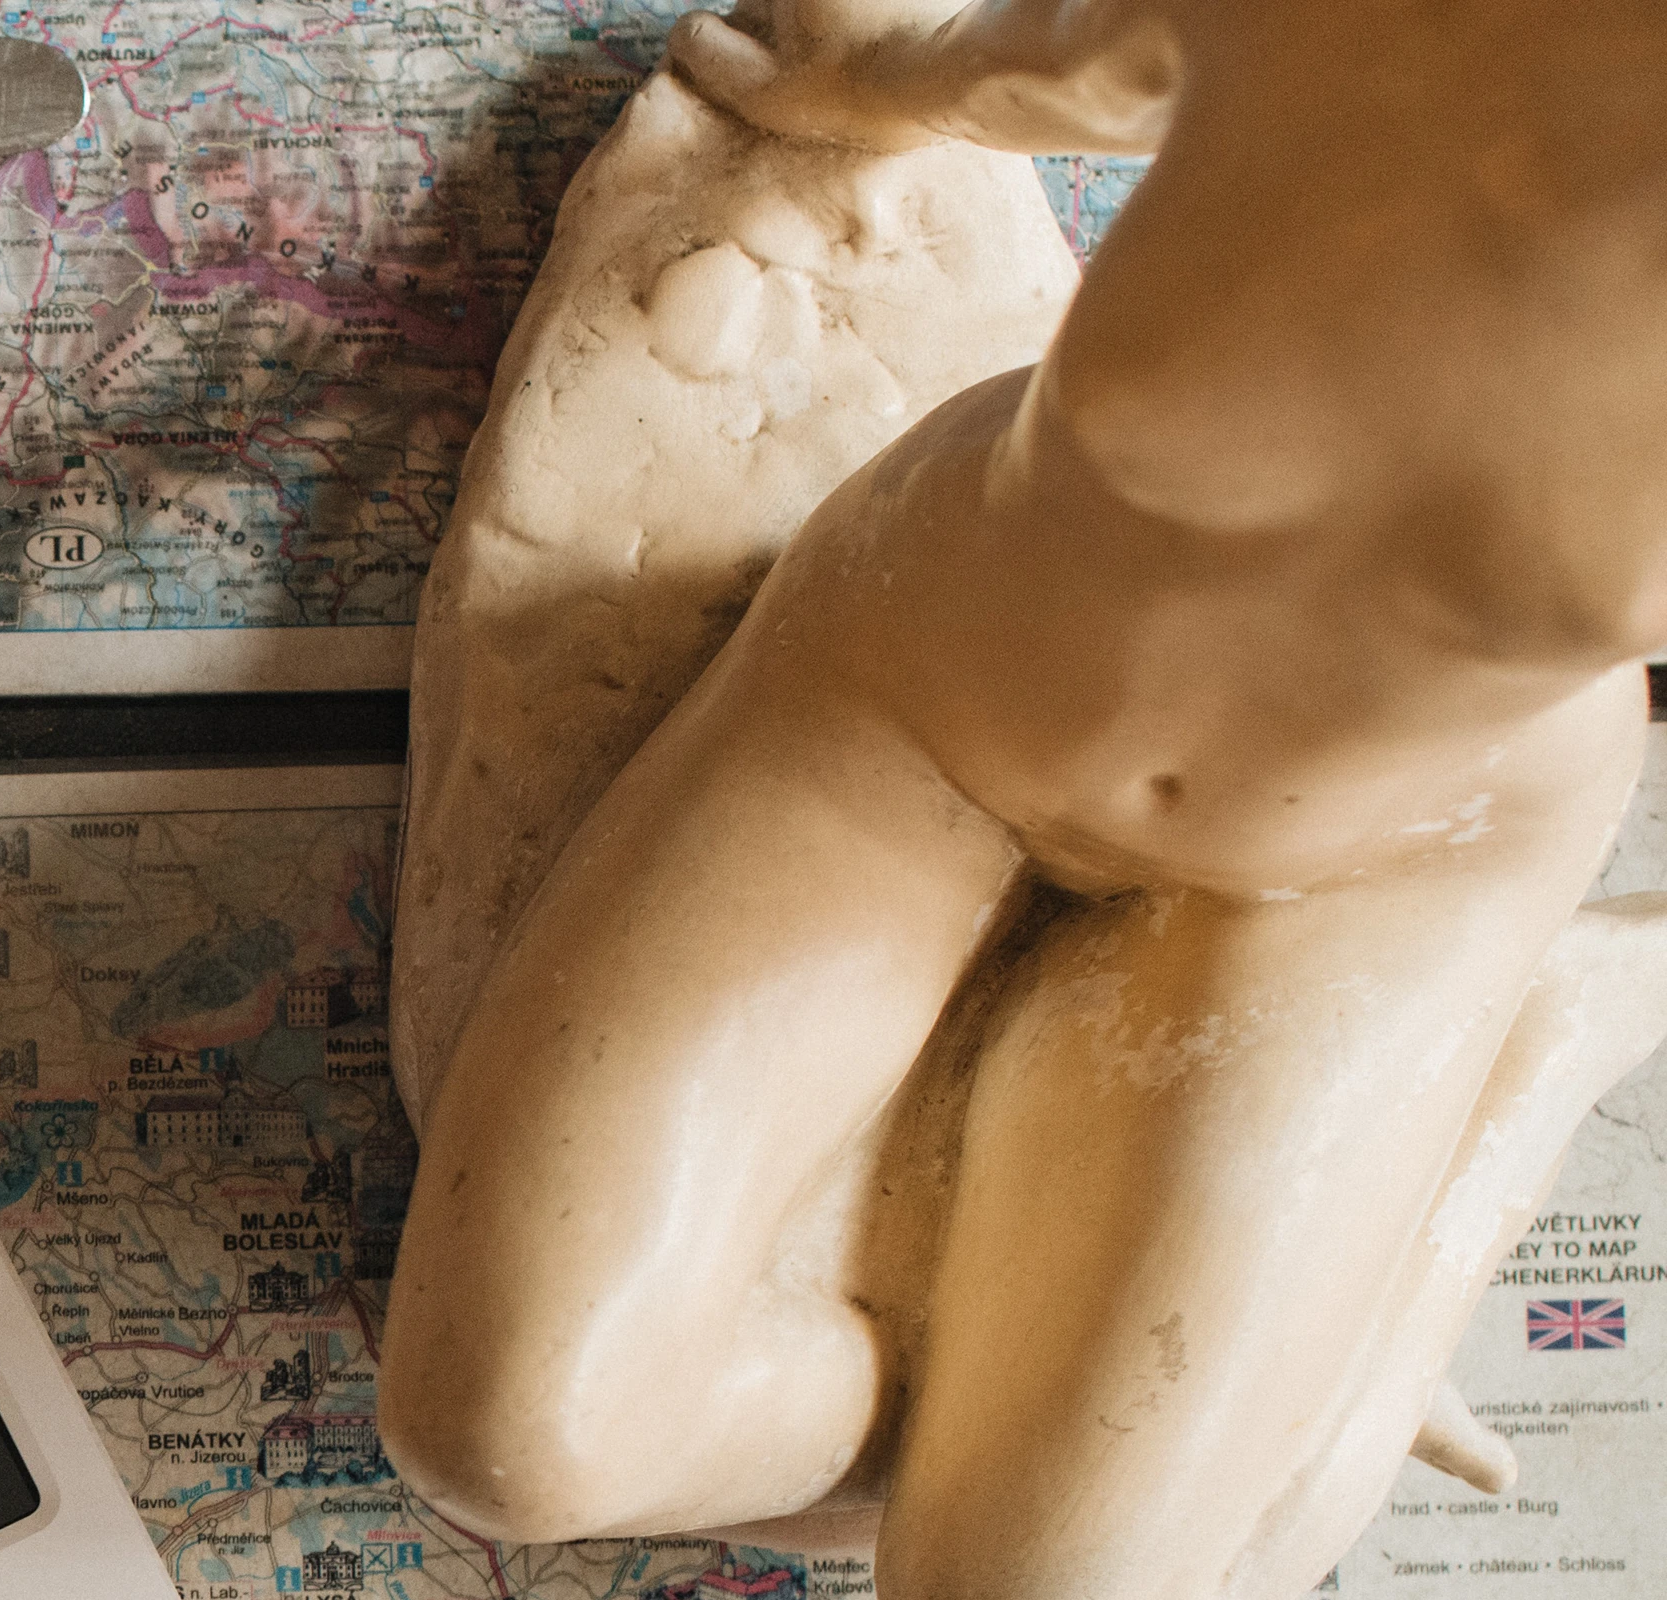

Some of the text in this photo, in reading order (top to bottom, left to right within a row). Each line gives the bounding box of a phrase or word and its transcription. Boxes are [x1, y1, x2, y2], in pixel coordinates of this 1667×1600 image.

[76, 48, 155, 61] TRUTNOV
[39, 535, 85, 562] PL
[81, 966, 141, 984] Doksy
[58, 1191, 109, 1207] Mšeno
[240, 1212, 319, 1231] MLADÁ
[223, 1232, 343, 1253] BOLESLAV
[1552, 1241, 1582, 1258] TO
[1589, 1240, 1637, 1257] MAP
[149, 1430, 247, 1450] BENÁTKY
[1390, 1498, 1559, 1517] hrad castle Burg
[1394, 1556, 1627, 1576] zámek château Schloss
